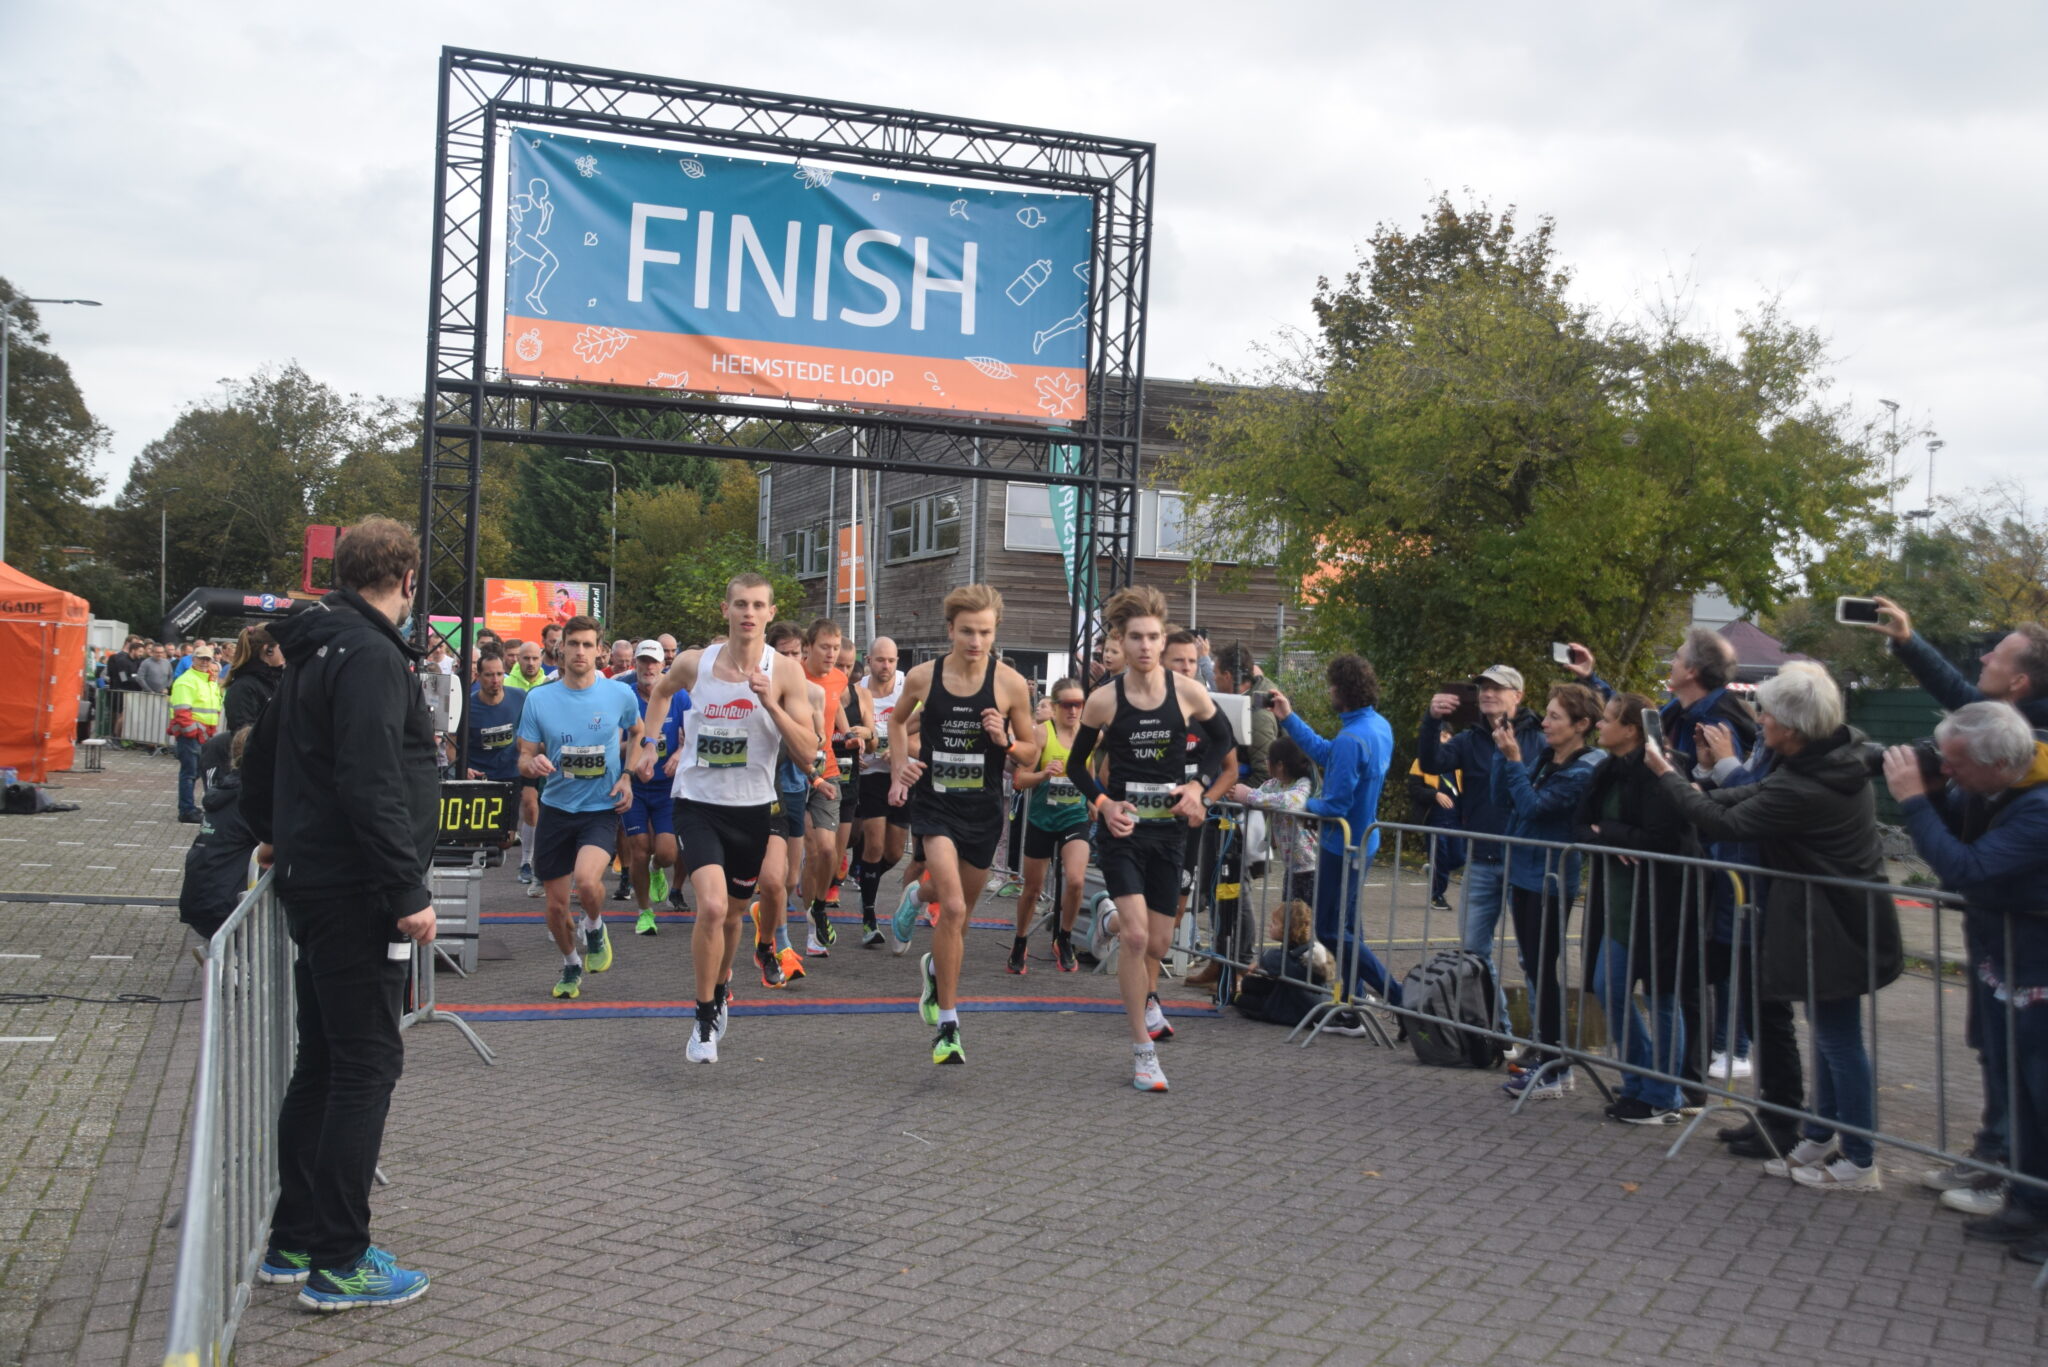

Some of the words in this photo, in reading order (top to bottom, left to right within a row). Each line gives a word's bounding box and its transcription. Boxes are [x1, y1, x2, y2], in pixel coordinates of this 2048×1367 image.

[627, 202, 978, 336] FINISH
[712, 353, 835, 383] HEEMSTEDE
[840, 366, 895, 387] LOOP
[0, 601, 45, 615] GADE
[941, 720, 982, 729] JASPERS
[561, 732, 573, 743] in
[1129, 730, 1172, 740] JASPERS
[697, 738, 748, 755] 2687
[562, 756, 605, 768] 2488
[933, 763, 982, 779] 2499
